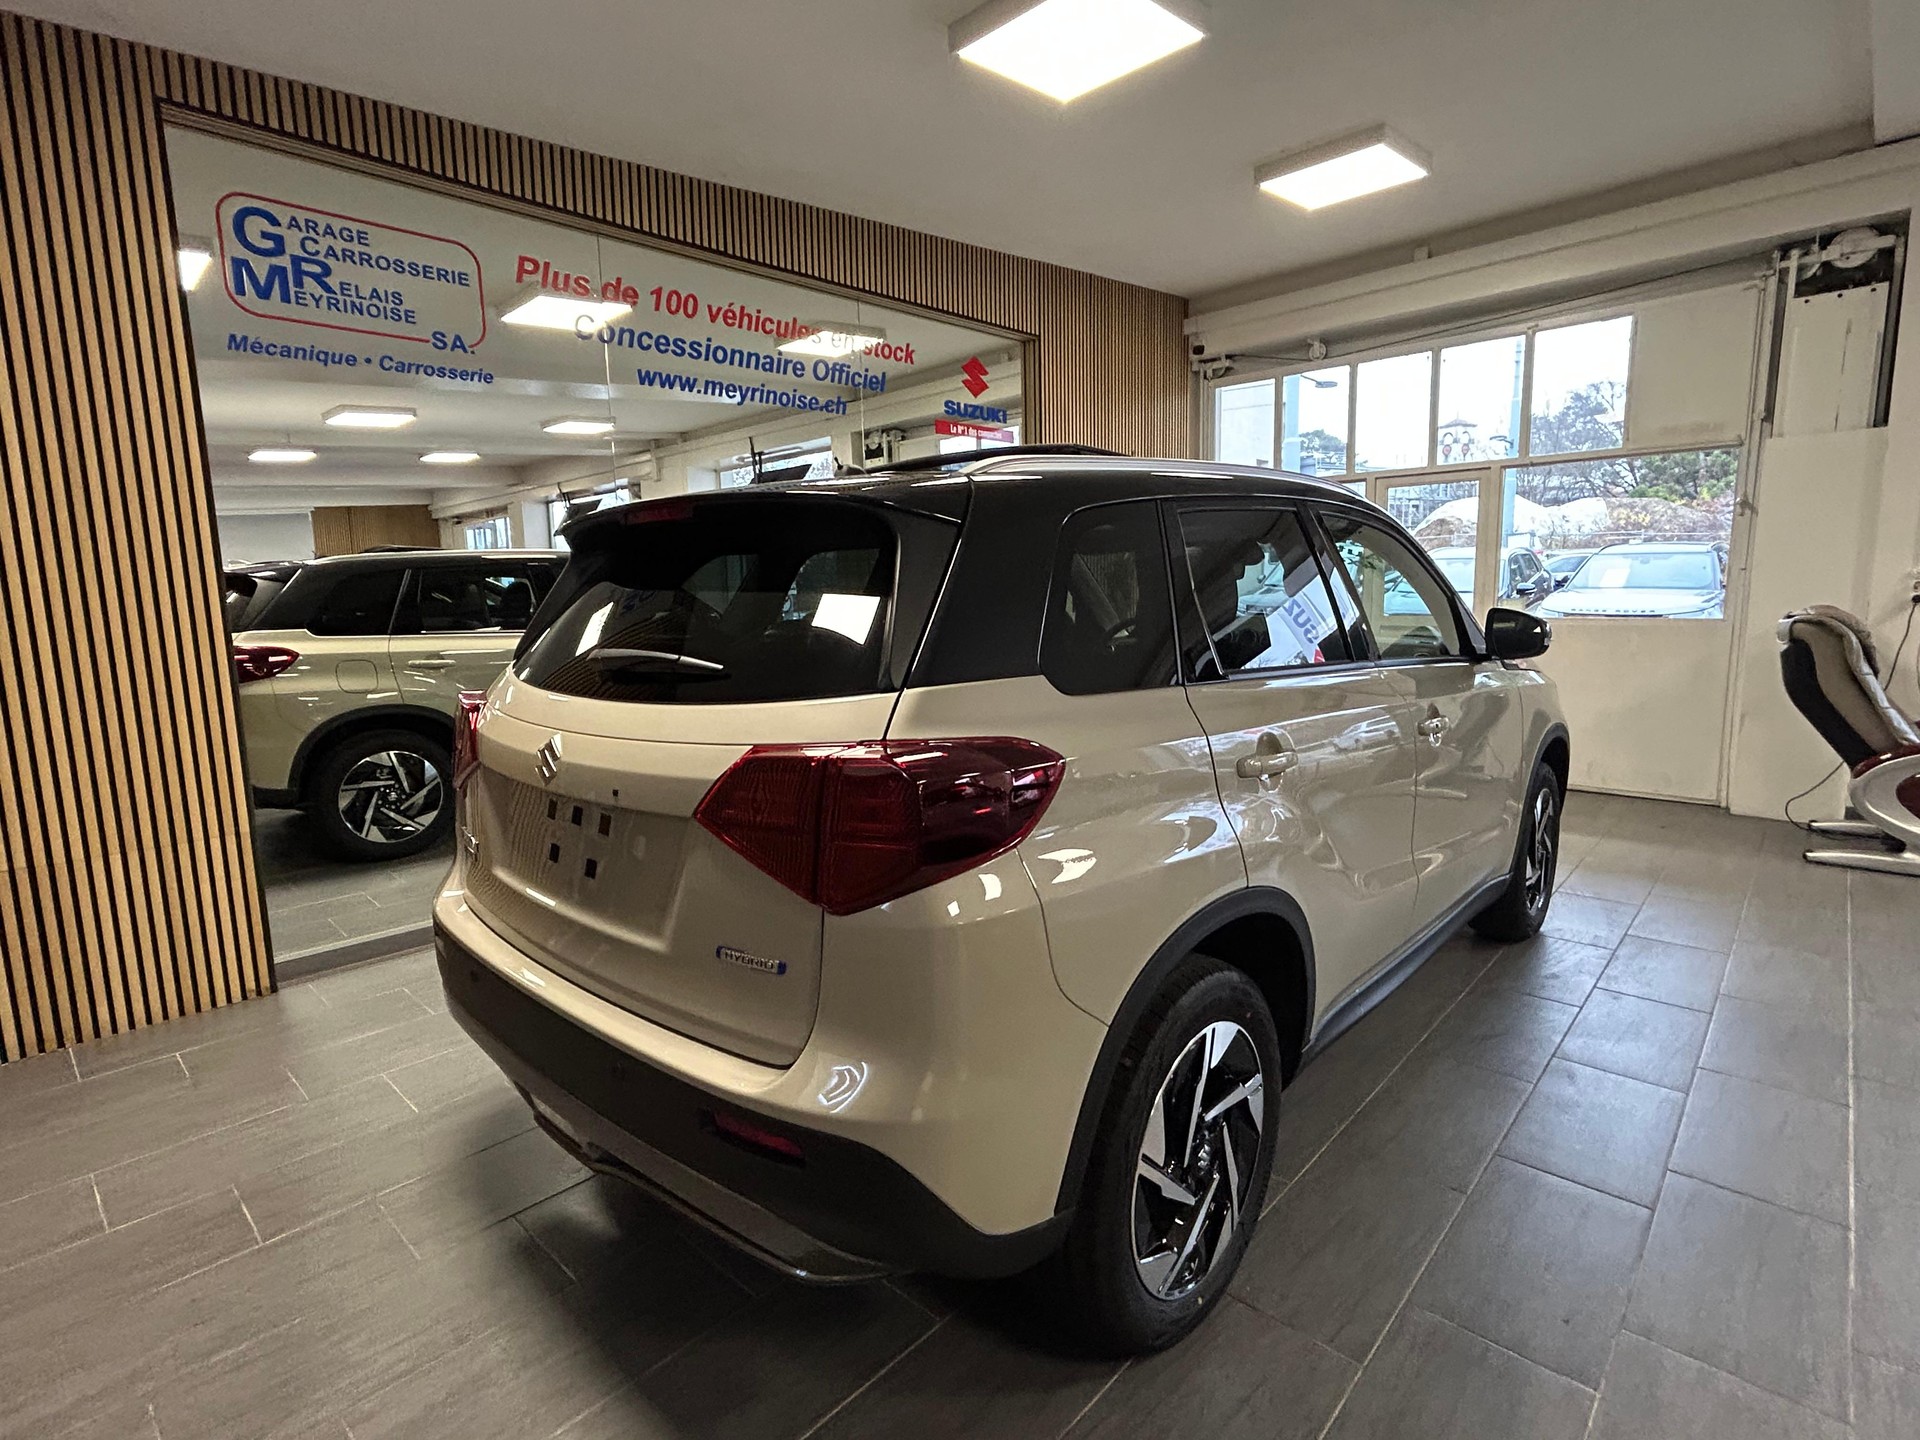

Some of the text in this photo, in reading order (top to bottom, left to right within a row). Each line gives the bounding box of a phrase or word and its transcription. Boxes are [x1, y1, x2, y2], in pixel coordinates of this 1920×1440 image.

[300, 236, 470, 287] CARROSSERIE
[516, 255, 591, 297] Plus
[601, 277, 639, 307] de
[650, 286, 699, 319] 100
[227, 333, 494, 384] Mécanique Carrosserie
[575, 314, 887, 392] Concessionnaire Officiel
[637, 369, 848, 415] www.meyrinoise.ch
[944, 400, 1007, 424] SUZUKI
[724, 950, 775, 970] HYBRID
